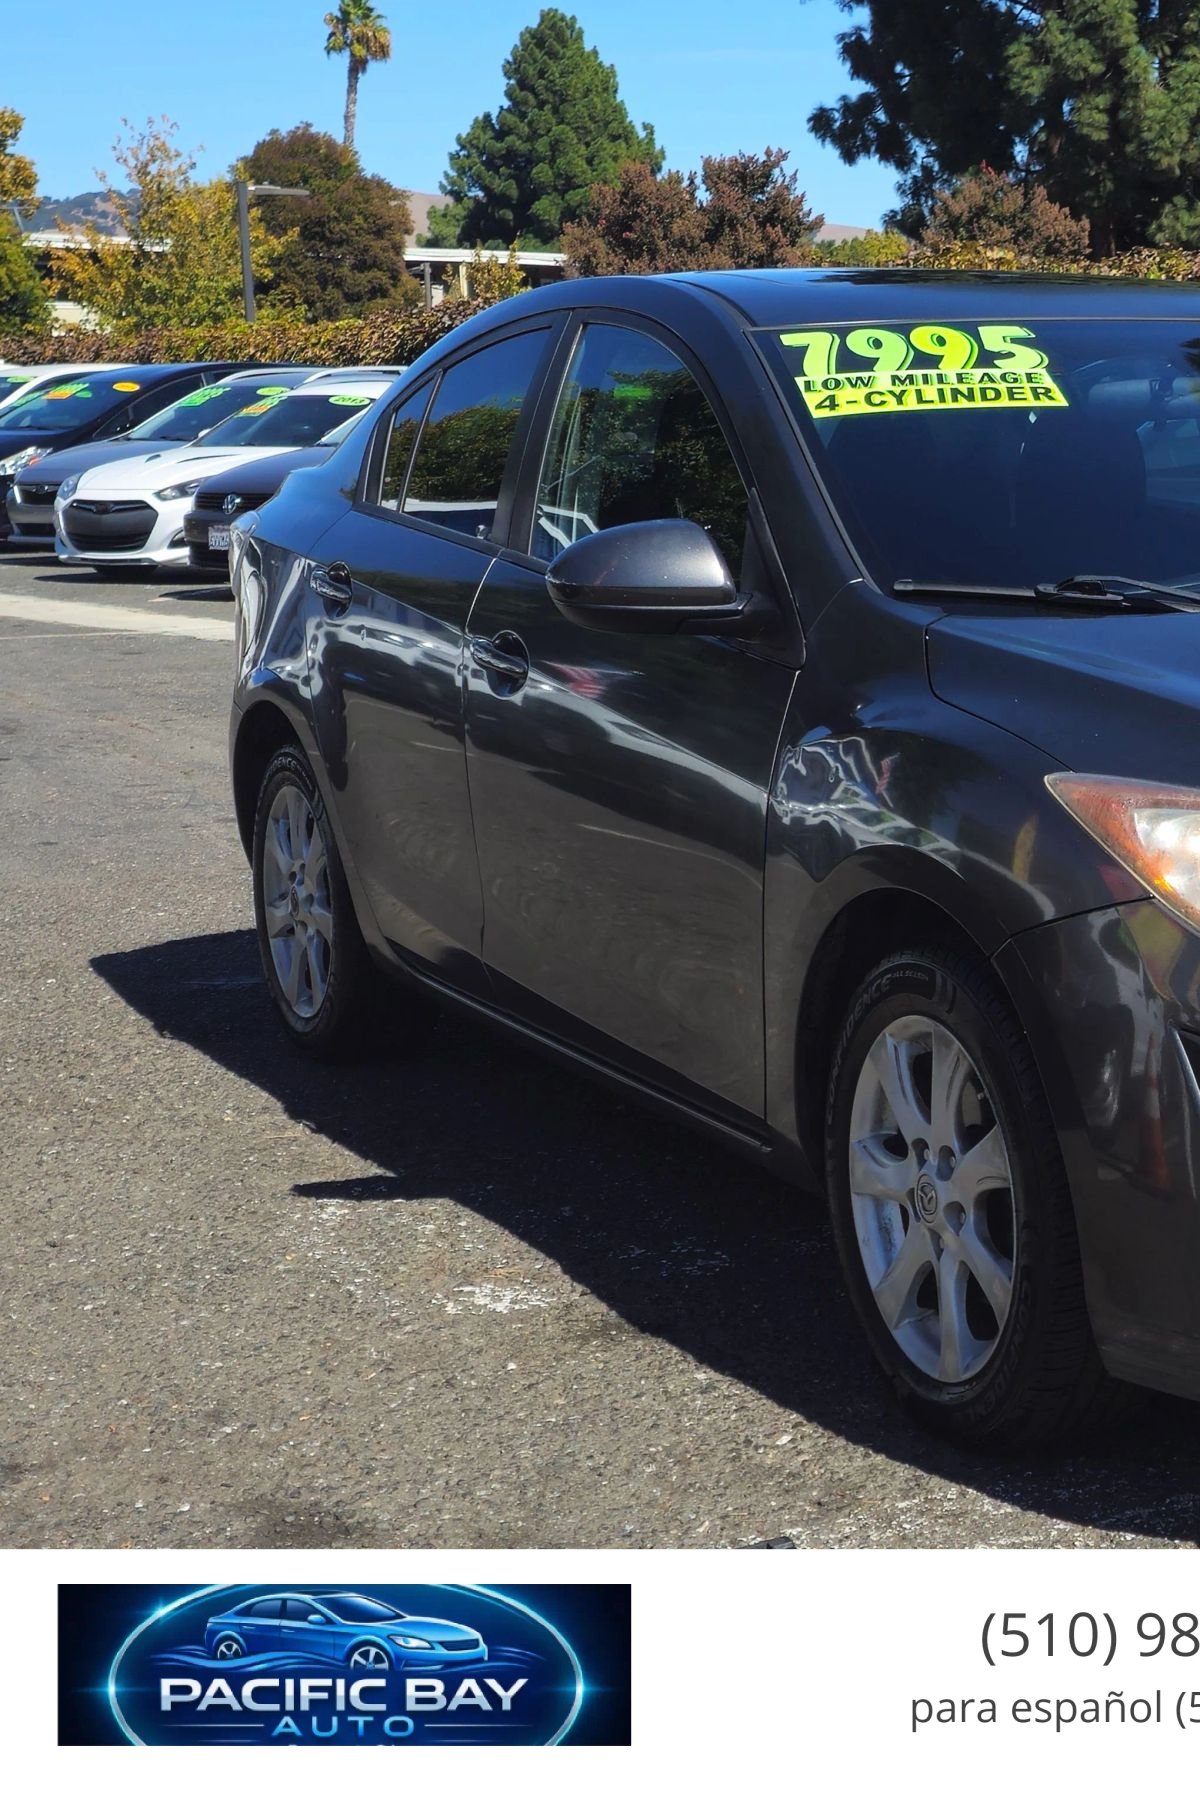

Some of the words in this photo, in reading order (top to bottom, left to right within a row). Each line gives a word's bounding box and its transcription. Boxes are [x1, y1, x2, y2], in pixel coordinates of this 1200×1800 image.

[779, 325, 1049, 381] 7995
[803, 374, 873, 393] LOW
[890, 371, 1047, 387] MILEAGE
[814, 386, 1060, 412] 4-CYLINDER
